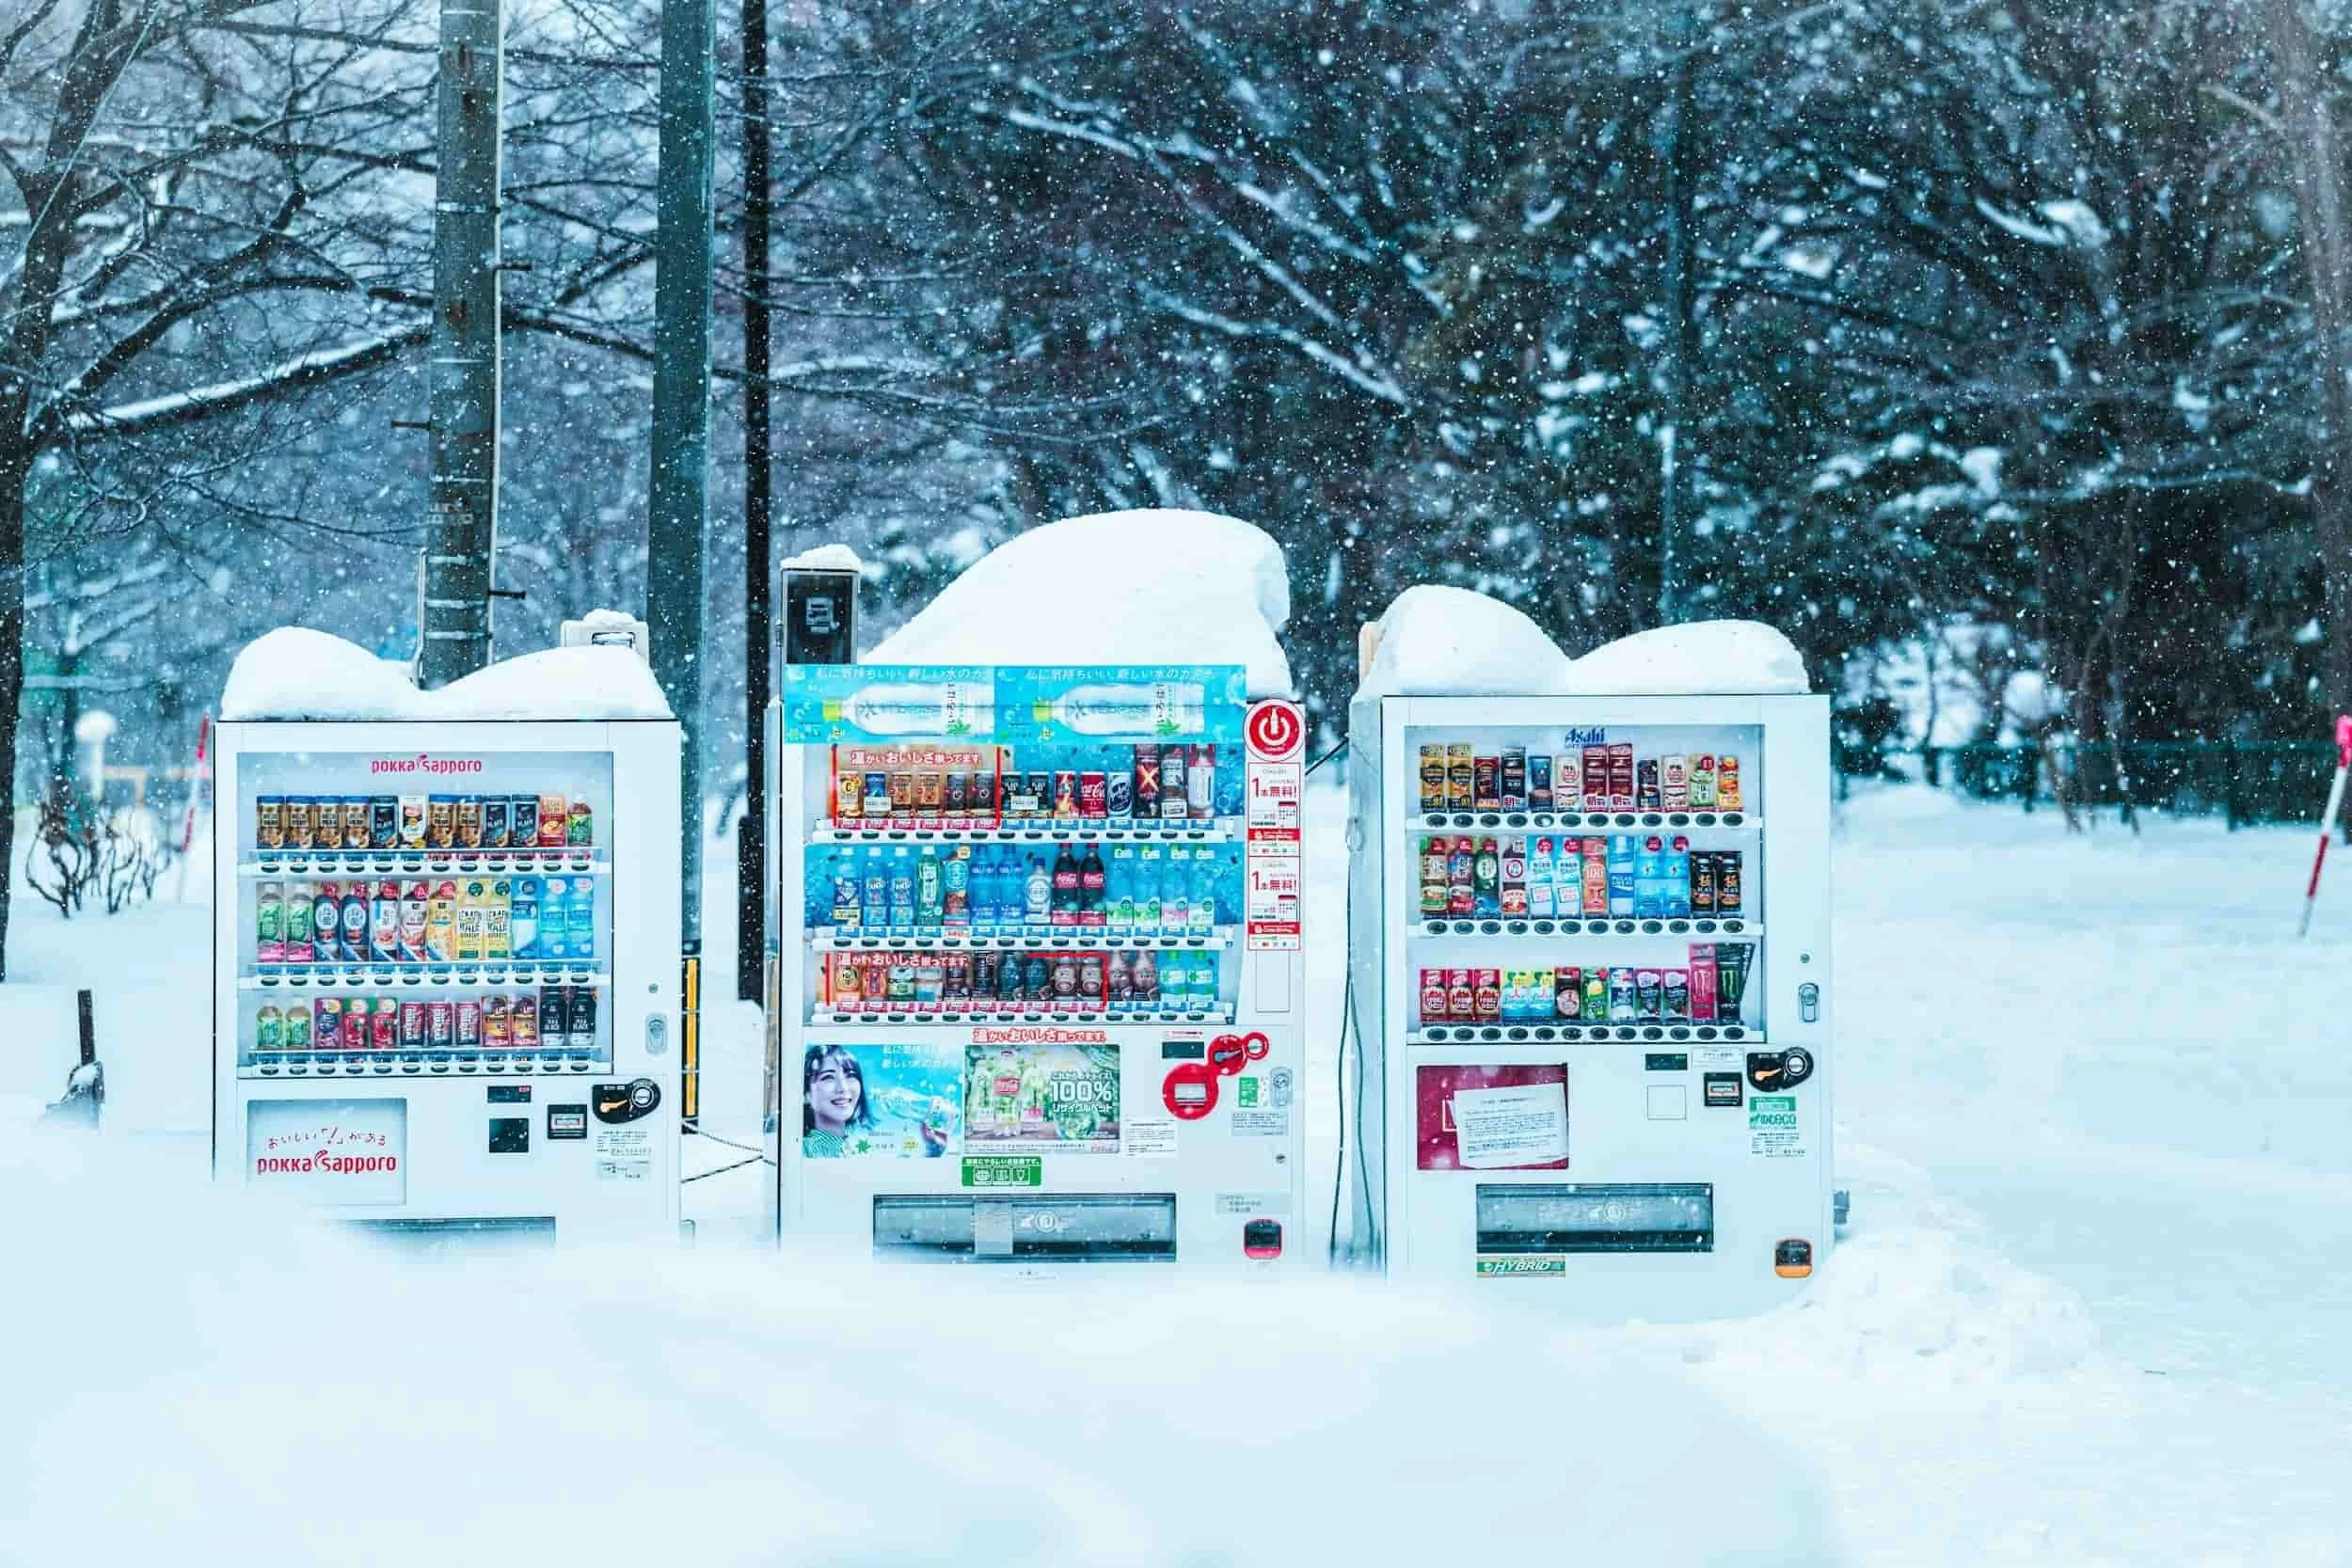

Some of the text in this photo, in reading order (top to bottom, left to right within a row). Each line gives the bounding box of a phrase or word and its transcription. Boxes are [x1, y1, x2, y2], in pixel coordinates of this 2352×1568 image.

[1565, 728, 1605, 744] Asahi
[1052, 1081, 1113, 1102] 100%
[1492, 1260, 1551, 1274] HYBRID
